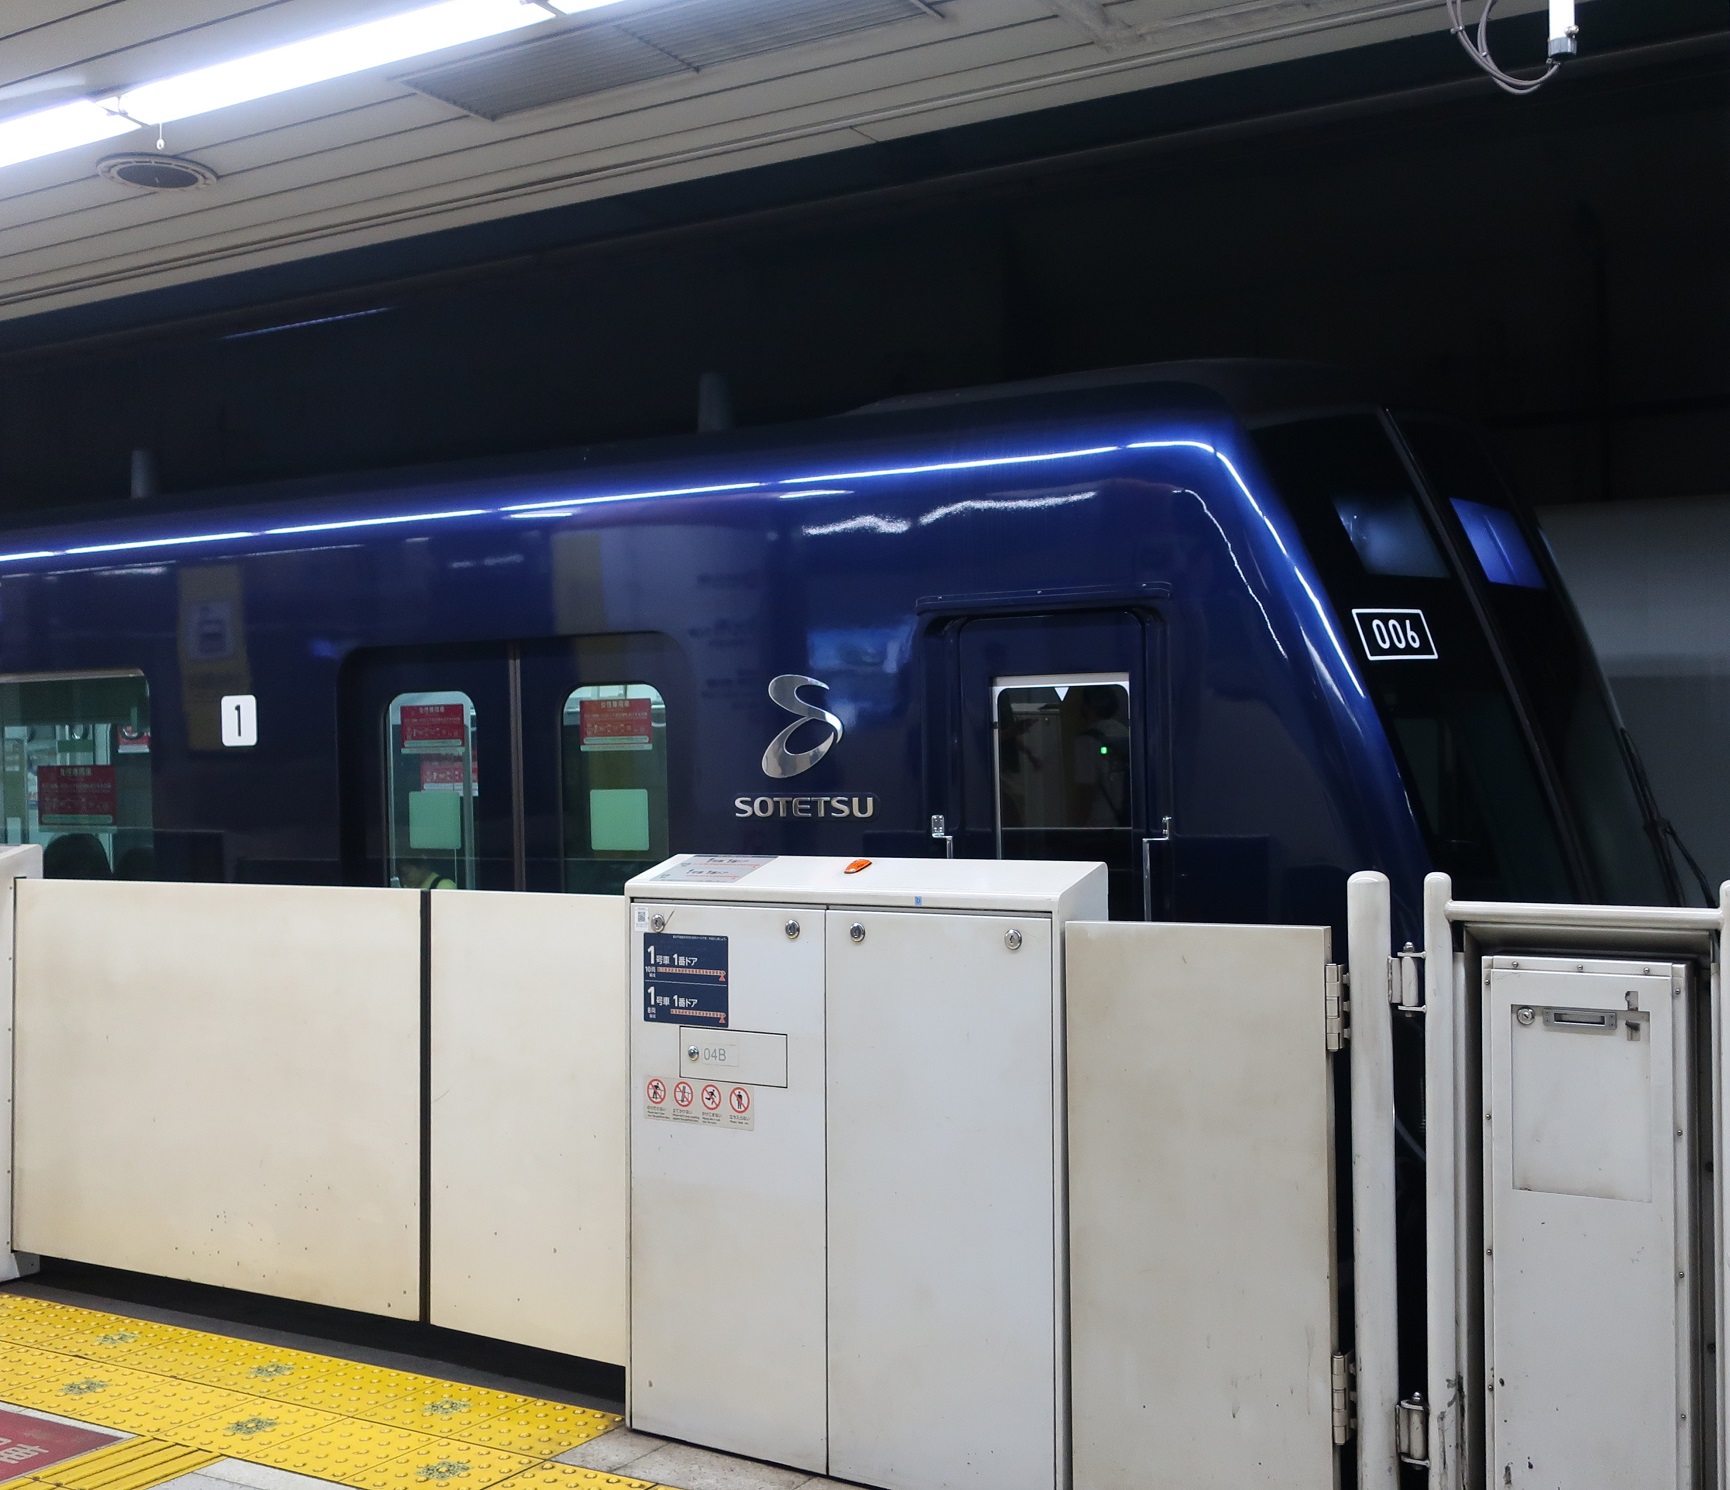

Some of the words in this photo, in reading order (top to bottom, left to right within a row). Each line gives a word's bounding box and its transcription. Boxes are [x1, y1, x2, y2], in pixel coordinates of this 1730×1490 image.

[1371, 619, 1421, 649] 006
[234, 704, 241, 736] 1
[734, 796, 874, 818] SOTETSU
[647, 945, 669, 964] 1号車
[673, 953, 698, 966] 1番ドア
[647, 986, 670, 1006] 1号車
[673, 994, 698, 1007] 1番ドア
[704, 1048, 726, 1061] 04B
